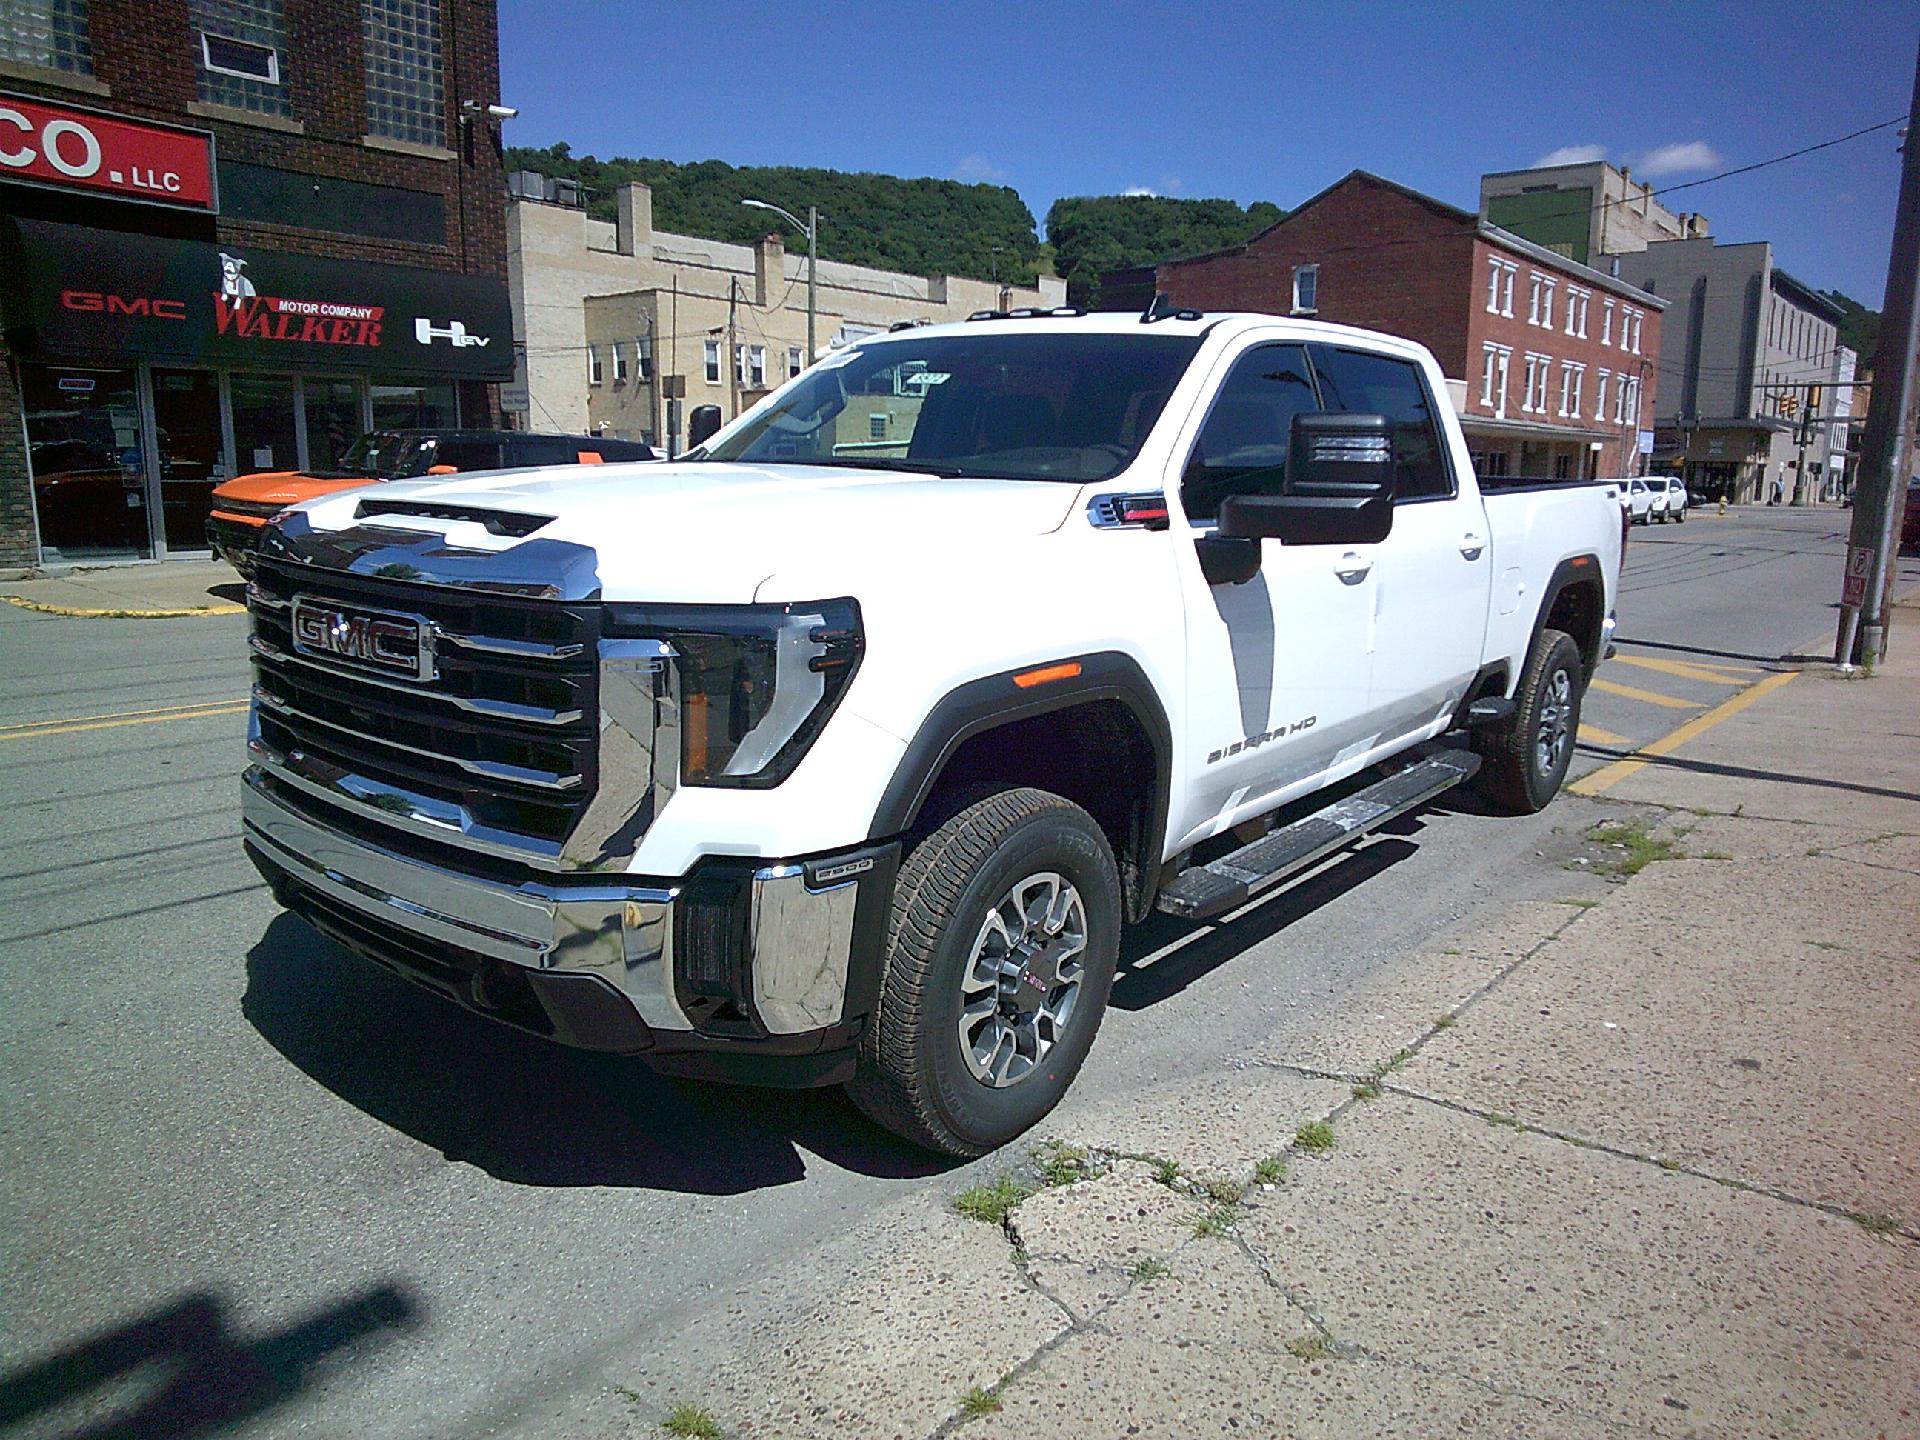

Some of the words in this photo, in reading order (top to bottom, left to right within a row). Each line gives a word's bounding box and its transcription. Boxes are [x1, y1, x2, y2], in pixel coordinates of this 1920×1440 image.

[132, 166, 181, 192] LLC
[62, 289, 187, 320] GMC
[212, 292, 383, 347] WALKER
[279, 300, 319, 315] MOTOR
[321, 304, 373, 319] COMPANY
[295, 603, 418, 671] GMC
[1206, 726, 1287, 765] SIERRA
[1289, 715, 1317, 735] HD
[818, 860, 872, 879] 2500
